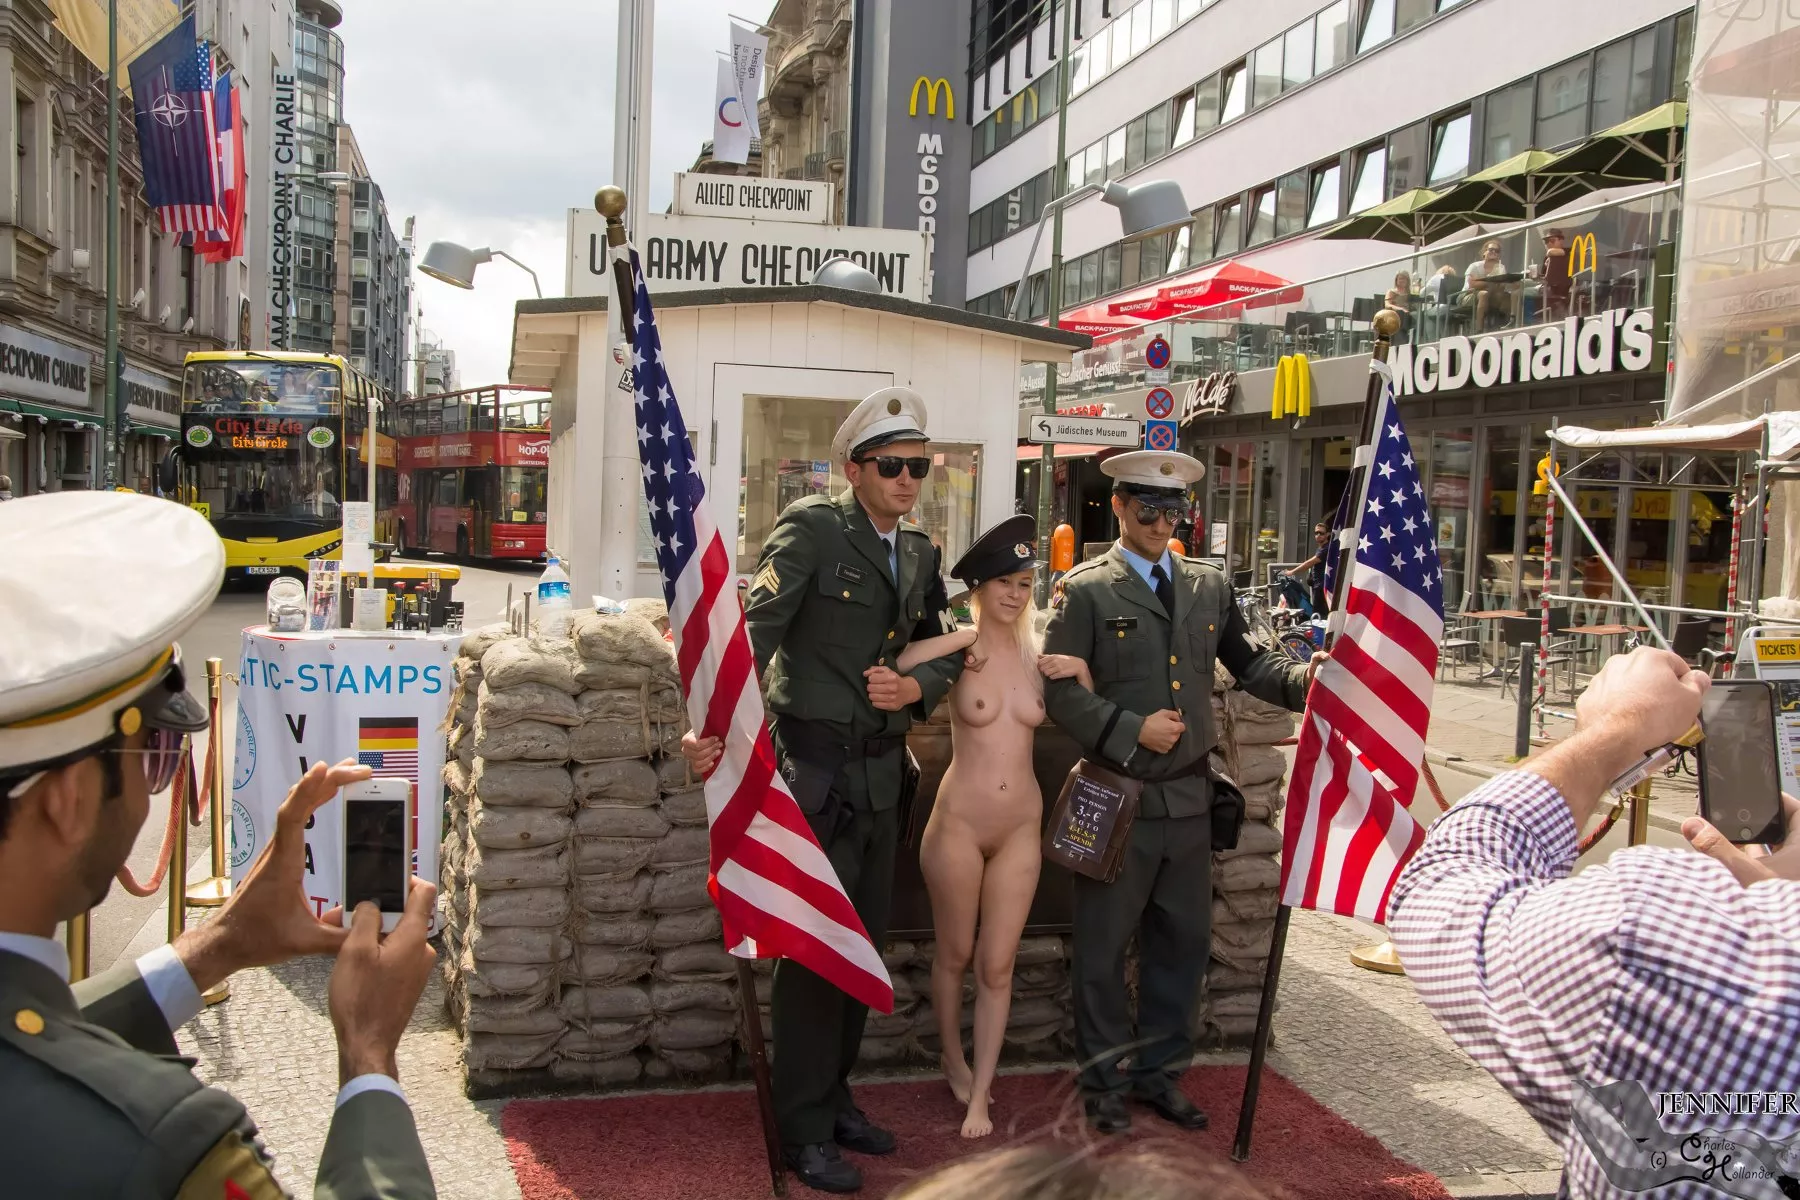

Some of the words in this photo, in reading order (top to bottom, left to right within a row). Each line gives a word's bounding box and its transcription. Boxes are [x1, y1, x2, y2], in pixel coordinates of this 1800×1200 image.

[748, 47, 762, 79] Design
[275, 74, 295, 165] CHARLIE
[695, 182, 734, 207] ALLIED
[739, 186, 813, 212] CHECKPOINT
[271, 170, 294, 309] CHECKPOINT
[646, 237, 728, 283] ARMY
[1387, 307, 1654, 397] McDonald's
[52, 357, 87, 393] CHARLIE
[1181, 371, 1237, 422] McCafé
[215, 417, 250, 436] City
[254, 416, 303, 435] Circle
[232, 436, 253, 449] City
[254, 436, 288, 449] Circle
[1056, 425, 1093, 436] Jüdisches
[1096, 427, 1128, 437] Museum
[1760, 644, 1797, 655] TICKETS
[242, 716, 255, 758] CHARLIE
[232, 803, 254, 838] CHARLIE
[1093, 812, 1102, 822] €
